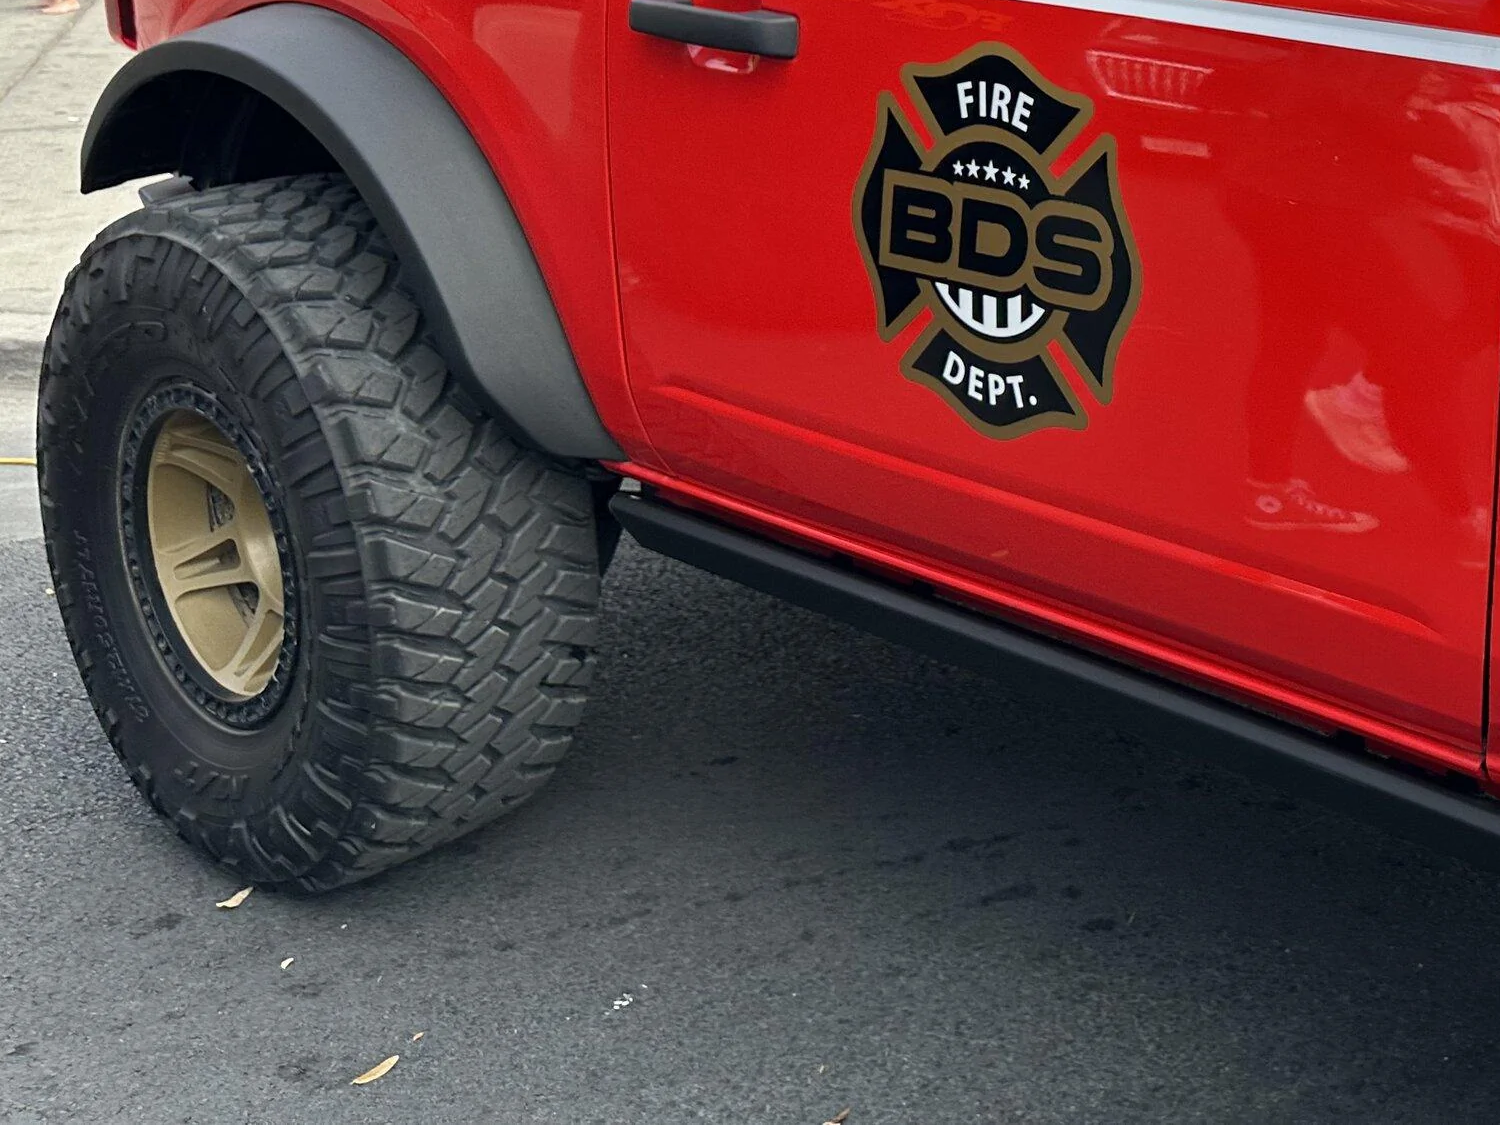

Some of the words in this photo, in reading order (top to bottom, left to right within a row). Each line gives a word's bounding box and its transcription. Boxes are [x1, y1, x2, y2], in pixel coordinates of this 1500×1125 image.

[956, 80, 1035, 133] FIRE
[887, 182, 1112, 298] BDS
[942, 350, 1038, 409] DEPT.
